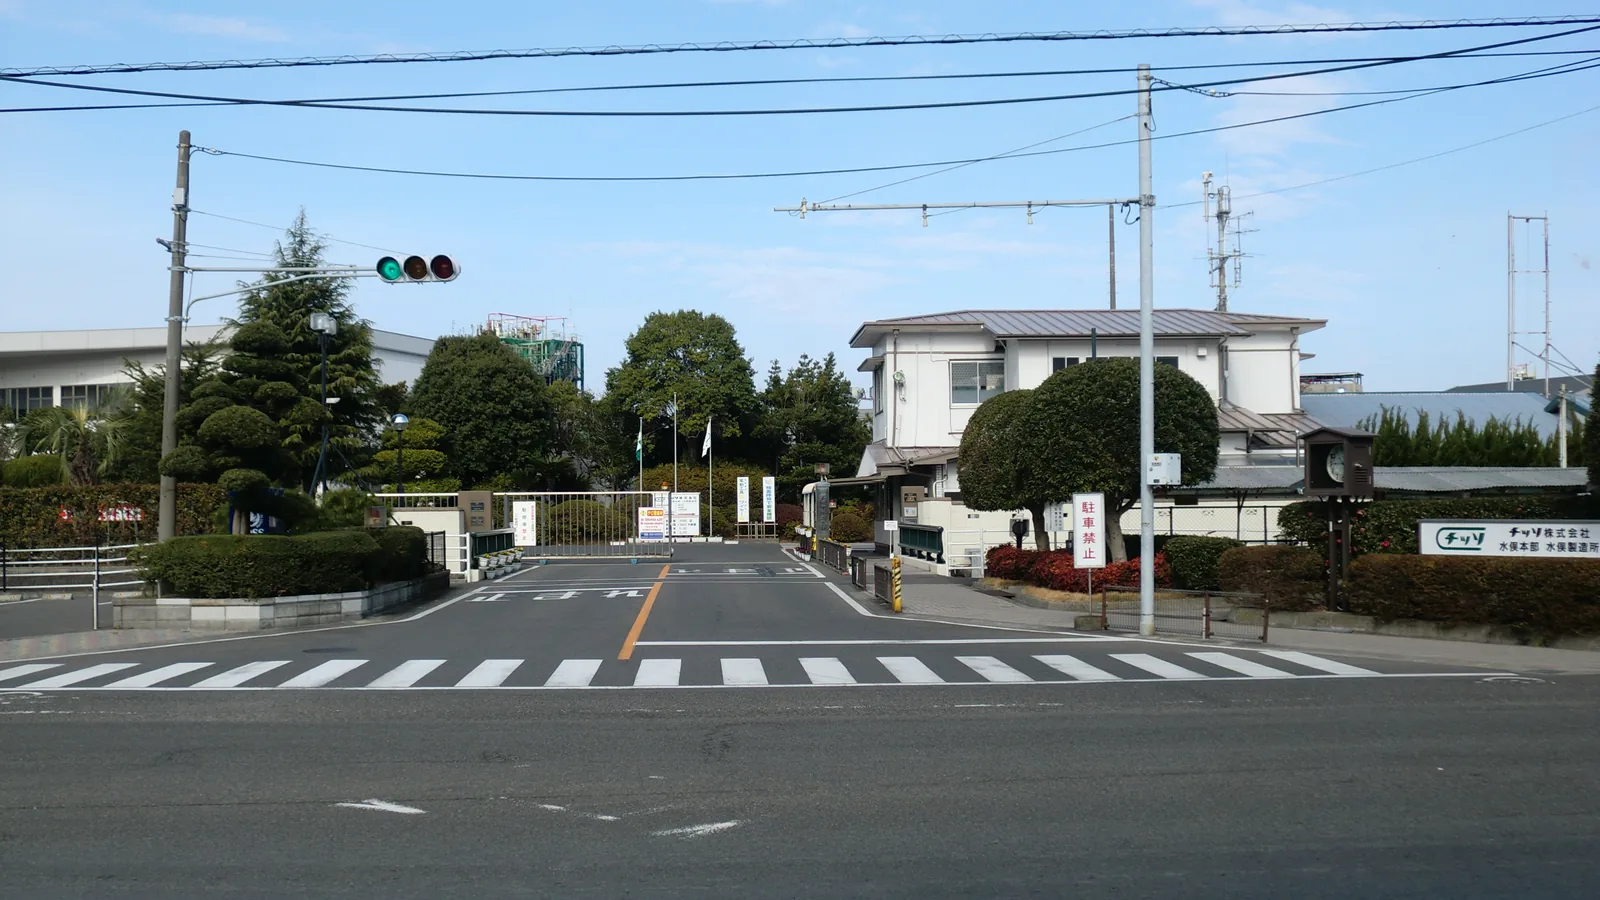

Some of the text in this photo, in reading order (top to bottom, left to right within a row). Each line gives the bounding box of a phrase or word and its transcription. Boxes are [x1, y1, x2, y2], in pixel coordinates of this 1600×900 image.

[1081, 501, 1096, 559] 駐車禁止
[1509, 527, 1591, 539] チッソ株式会社
[1444, 532, 1486, 546] チッソ
[1499, 541, 1599, 553] 水俣本部 水俣製造所
[465, 590, 644, 602] 止まれ
